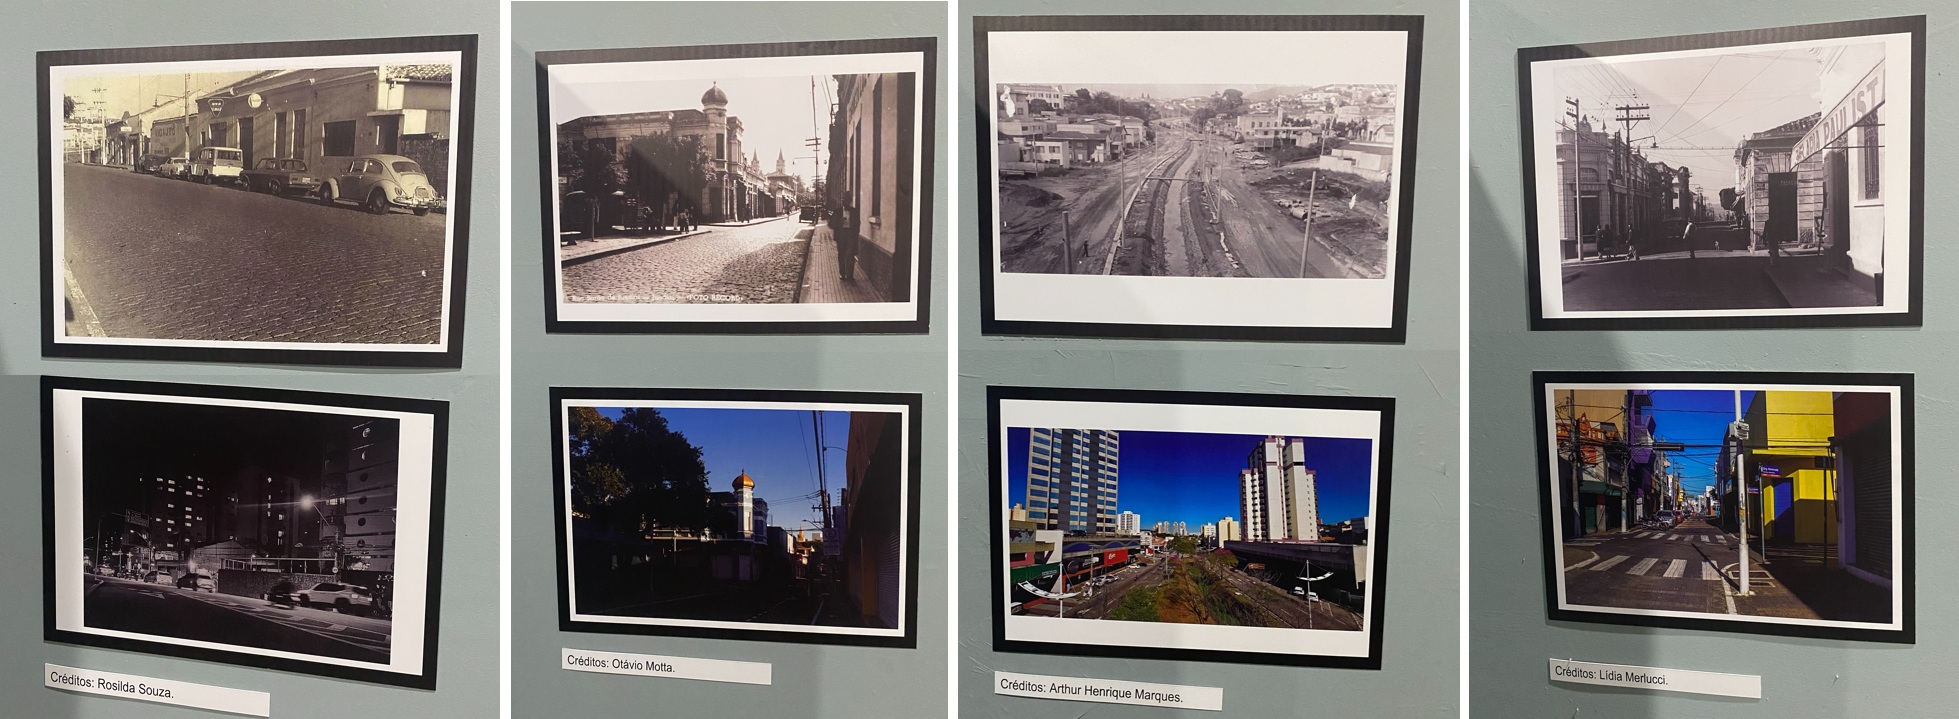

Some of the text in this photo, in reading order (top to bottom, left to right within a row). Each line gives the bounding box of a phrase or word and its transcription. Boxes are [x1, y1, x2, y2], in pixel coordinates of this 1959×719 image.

[567, 654, 676, 673] Créditos: Otávio Motta.
[1555, 665, 1668, 685] Créditos: Lídia Merlucci.
[50, 671, 175, 699] Créditos: Rosilda Souza.
[1000, 678, 1183, 704] Créditos: Arthur Henrique Marques.
